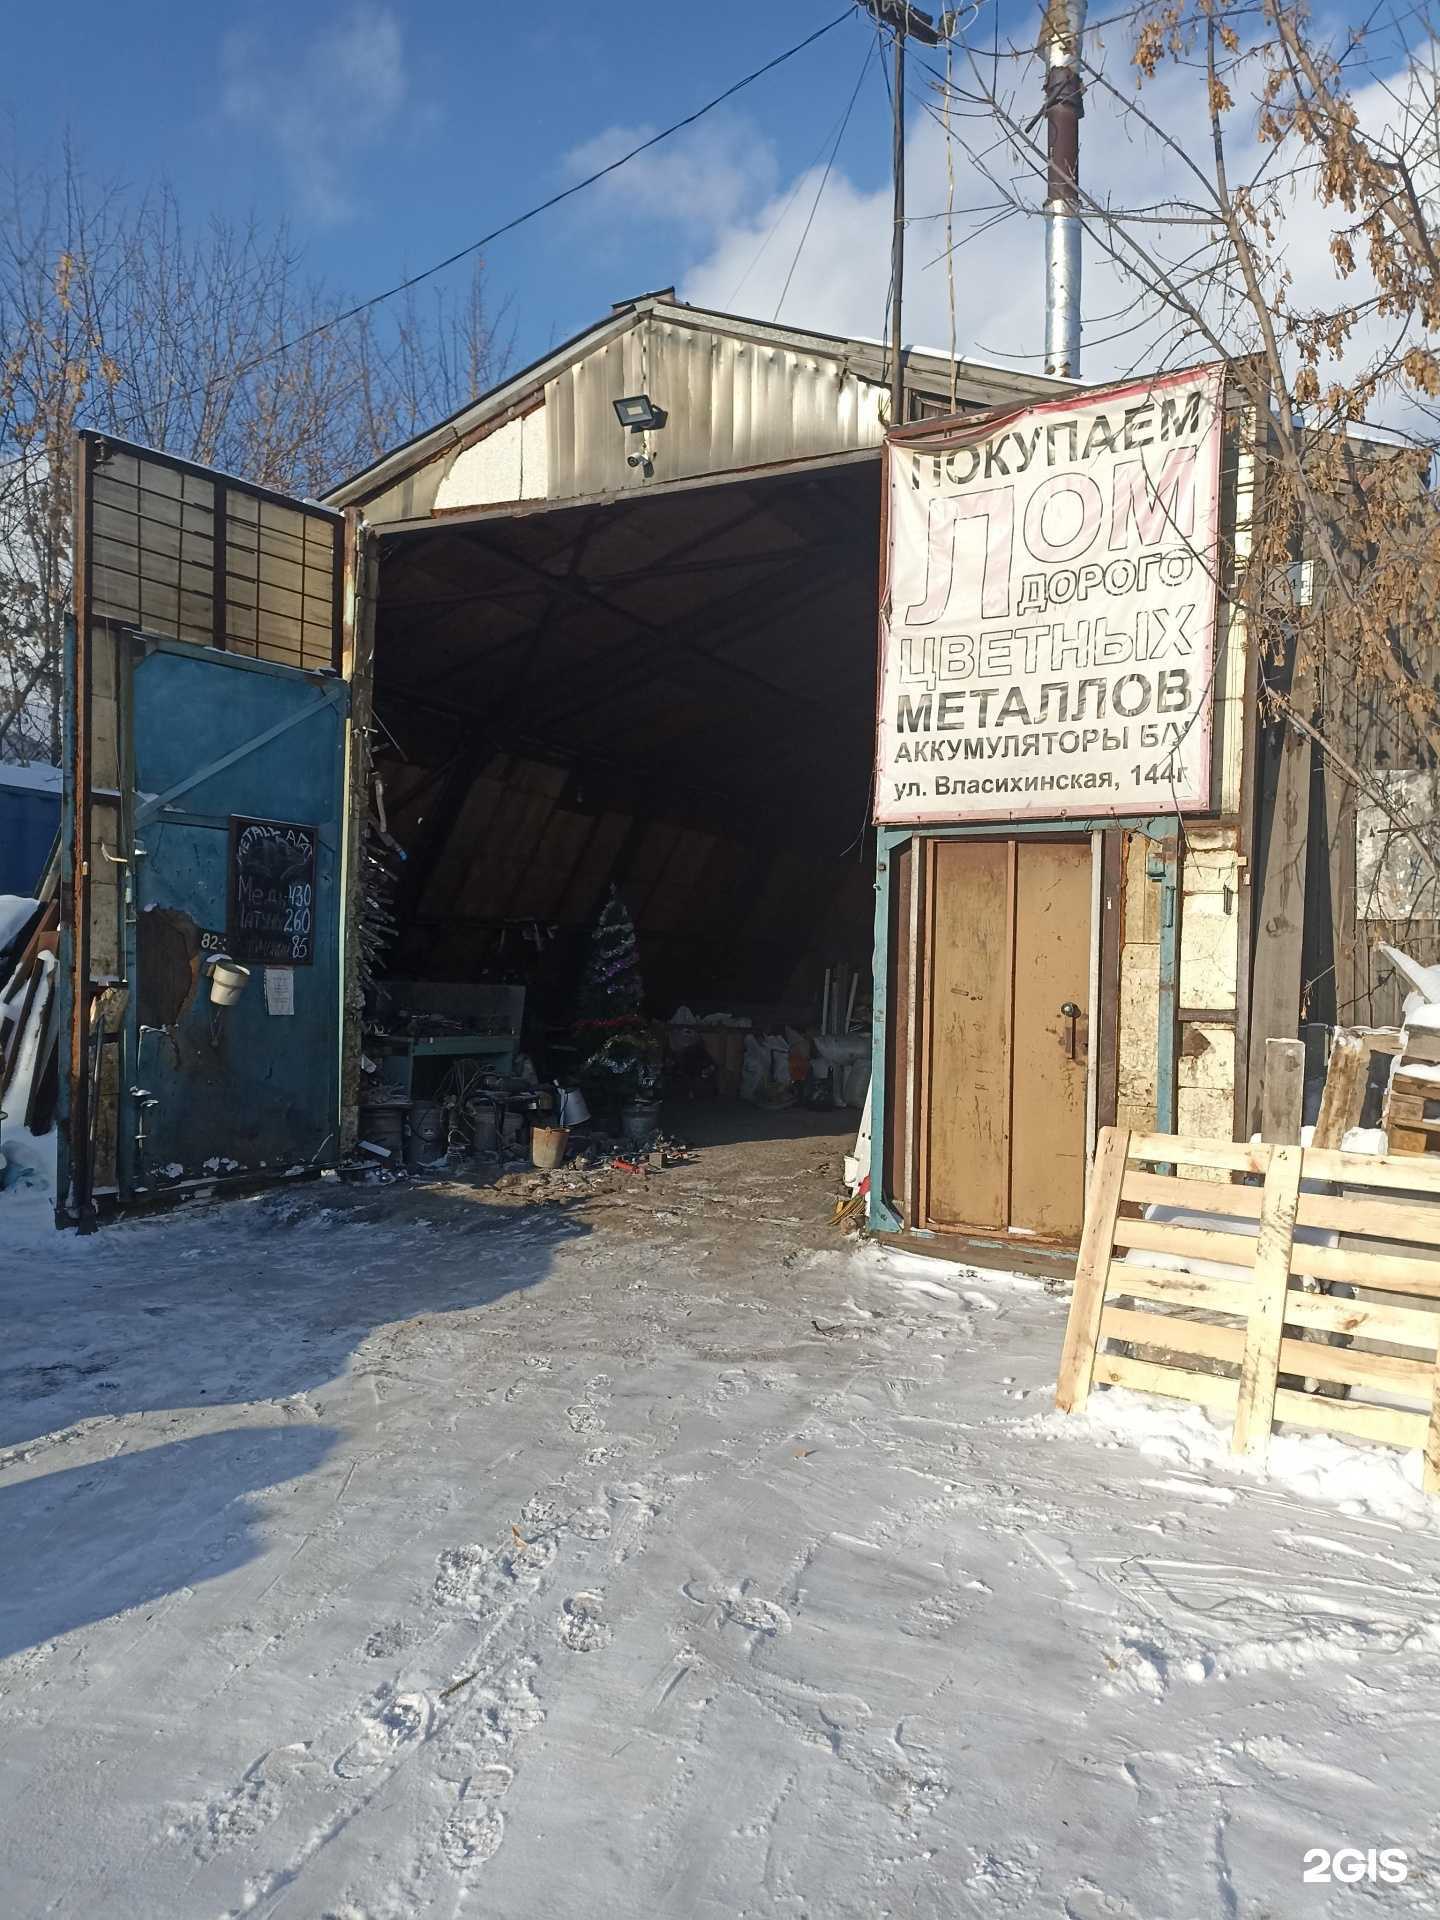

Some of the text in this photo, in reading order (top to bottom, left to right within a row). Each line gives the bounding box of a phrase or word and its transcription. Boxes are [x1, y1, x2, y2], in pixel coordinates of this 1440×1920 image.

[912, 391, 1200, 490] ПОКУПАЕМ
[905, 446, 1197, 626] ЛОМ
[1017, 548, 1193, 615] ДОРОГО
[900, 604, 1196, 691] ЦВЕТНЫХ
[895, 668, 1193, 733] МЕТАЛЛОВ
[894, 720, 1191, 763] АККУМУЛЯТОРЫ Б/У
[894, 780, 927, 802] ул.
[934, 770, 1120, 796] Власихинская,
